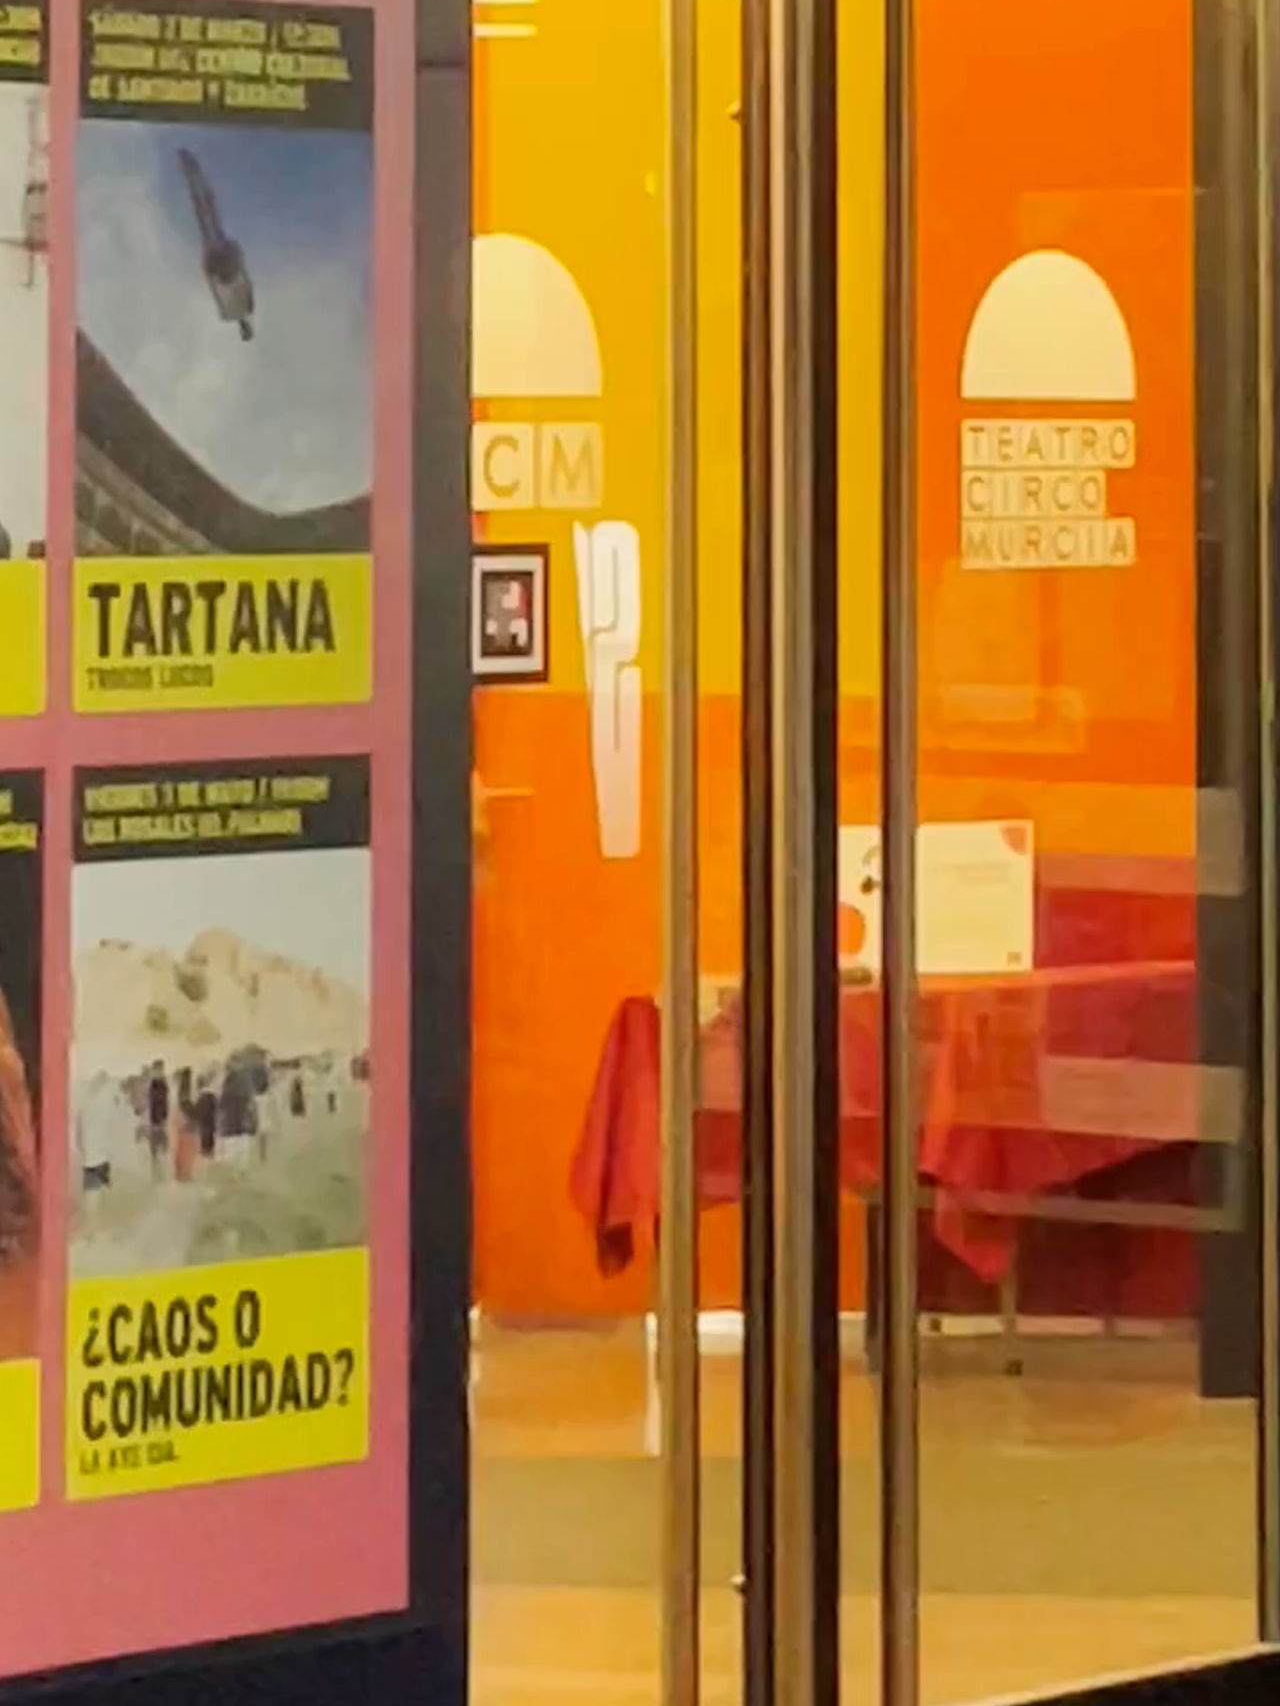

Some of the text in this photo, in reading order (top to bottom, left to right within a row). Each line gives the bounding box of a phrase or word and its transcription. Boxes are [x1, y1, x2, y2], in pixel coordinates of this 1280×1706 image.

[969, 426, 1128, 461] TEATRO
[967, 476, 1099, 511] CIRCO
[967, 525, 1127, 561] MURCIA
[87, 578, 336, 658] TARTANA
[82, 1290, 260, 1368] ¿CAOS O
[82, 1348, 353, 1441] COMUNIDAD?
